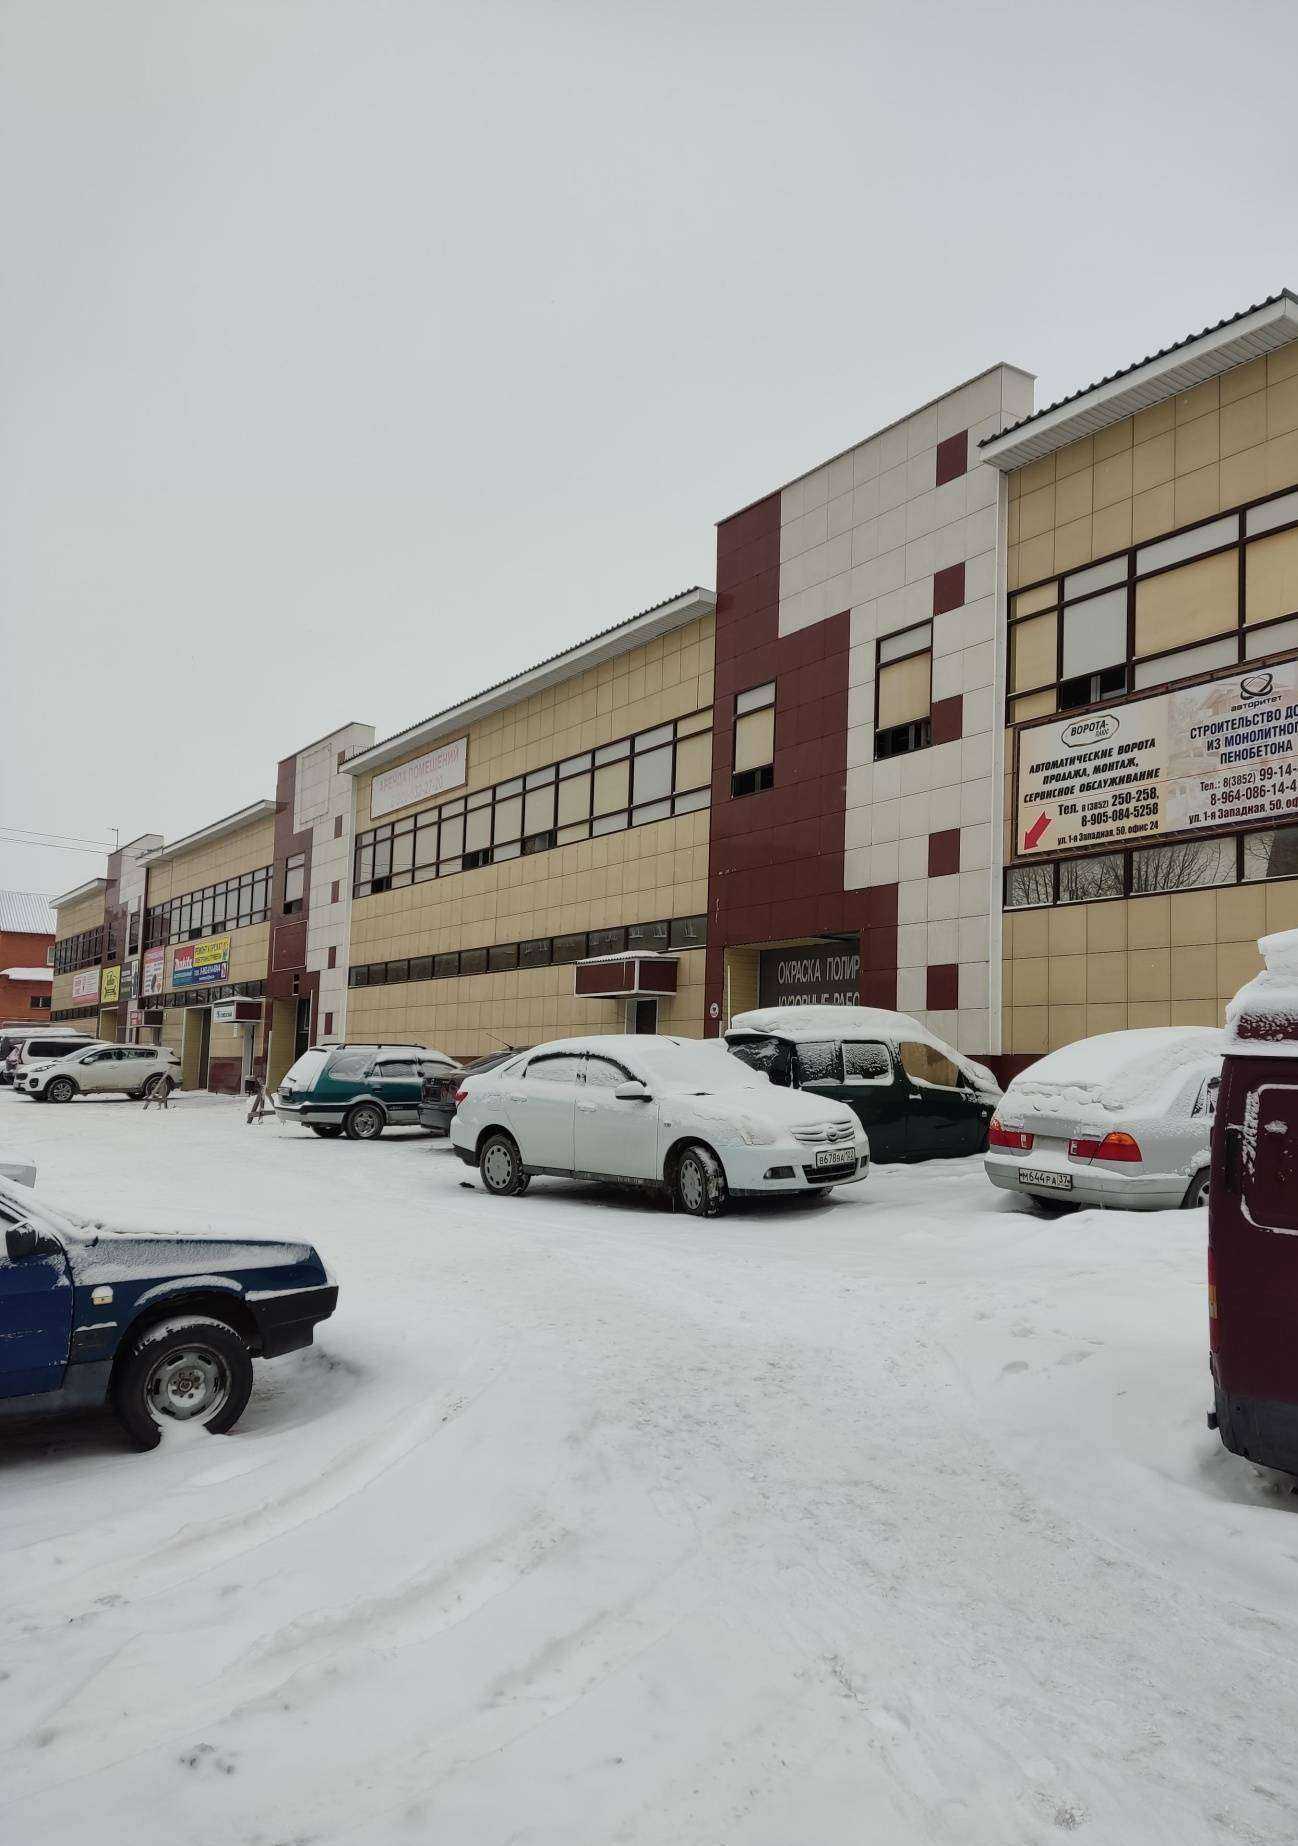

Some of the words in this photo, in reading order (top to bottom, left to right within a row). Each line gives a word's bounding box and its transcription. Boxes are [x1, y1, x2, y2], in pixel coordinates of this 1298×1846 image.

[1230, 694, 1282, 712] авторитет
[1190, 708, 1281, 740] СТРОИТЕЛЬСТВО
[1029, 747, 1114, 774] АВТОМАТИЧЕСКИЕ
[1117, 738, 1156, 756] ВОРОТА
[1206, 737, 1222, 752] ИЗ
[1220, 739, 1294, 765] ПЕНОБЕТОНА
[1042, 767, 1090, 786] ПРОДАЖА,
[1092, 756, 1139, 775] МОНТАЖ,
[1024, 785, 1076, 803] СЕРВИСНОЕ
[1079, 767, 1161, 793] ОБСЛУЖИВАНИЕ
[1058, 803, 1079, 816] Тел.
[1081, 802, 1159, 827] 8-905-084-5258
[1188, 812, 1202, 826] ул.
[1203, 810, 1217, 822] 1-я
[1057, 832, 1068, 846] ул.
[1068, 833, 1078, 844] 1-я
[1128, 823, 1149, 835] офис
[1149, 820, 1159, 831] 24
[777, 957, 822, 985] ОКРАСКА
[826, 955, 860, 981] ПОЛИР
